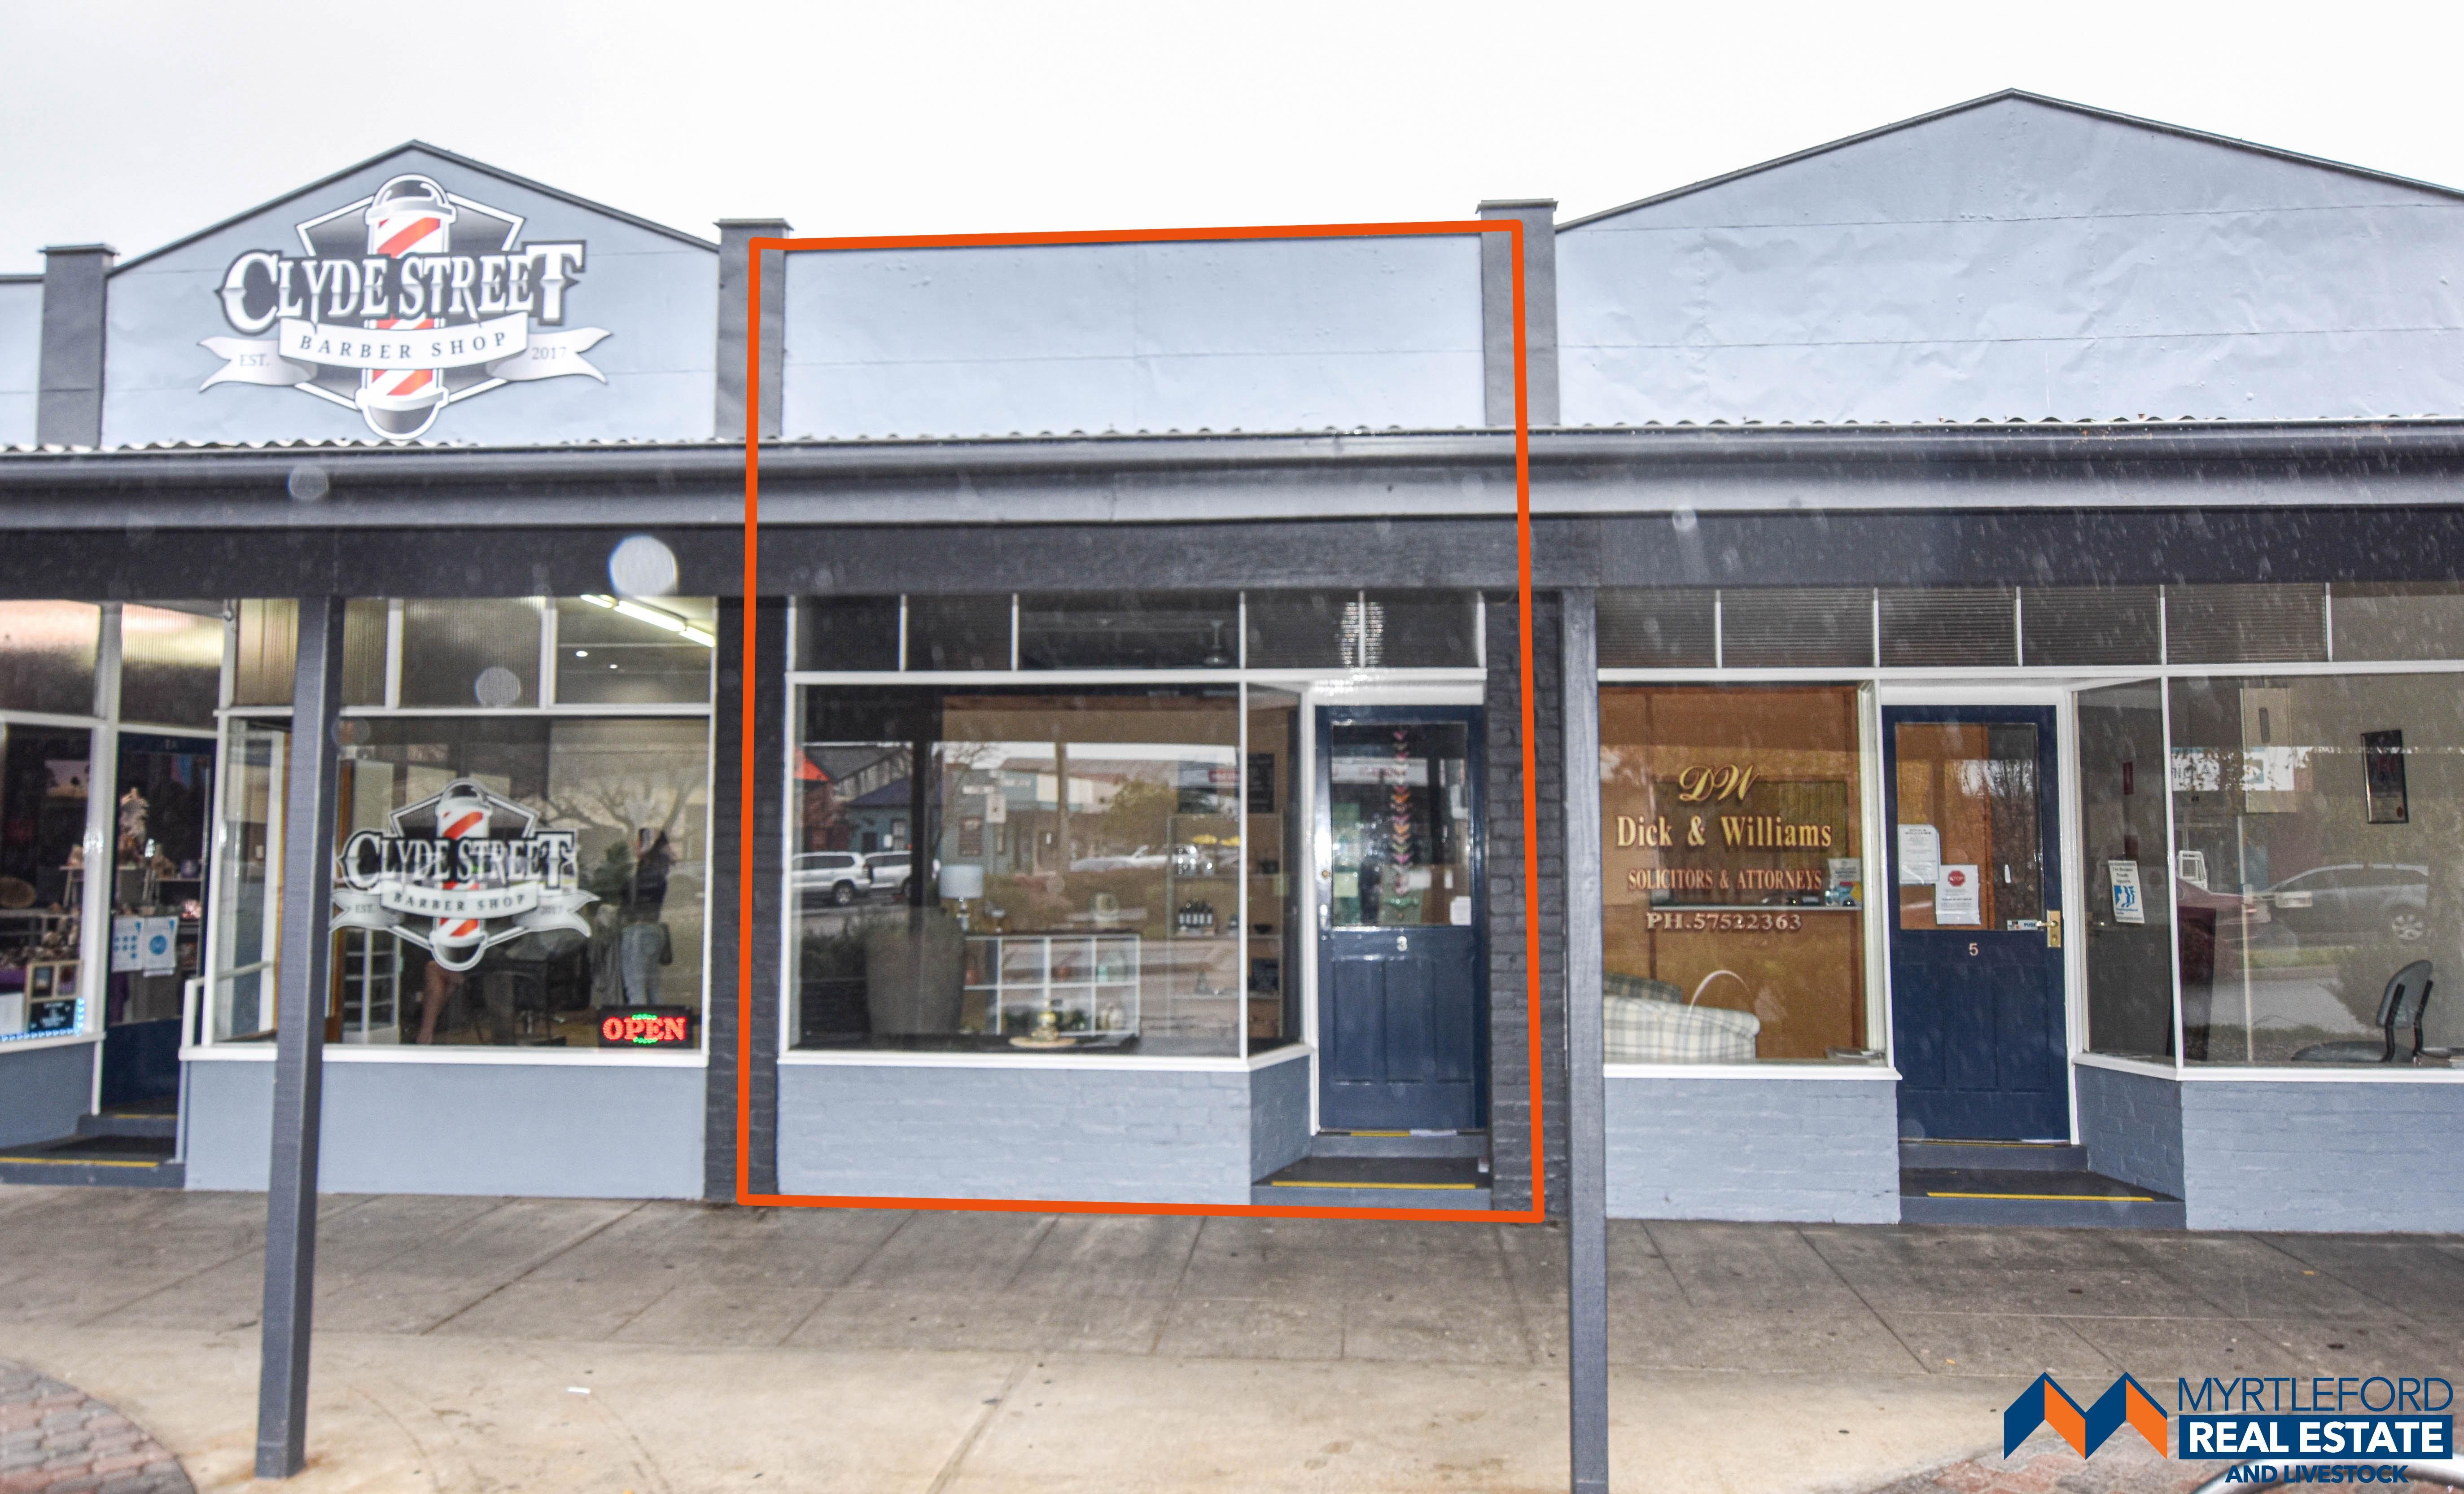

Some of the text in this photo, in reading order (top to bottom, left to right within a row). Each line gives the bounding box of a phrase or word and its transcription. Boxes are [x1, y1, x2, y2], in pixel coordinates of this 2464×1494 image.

[221, 243, 583, 333] CLYDE STREET
[240, 346, 567, 367] EST. 2017
[300, 332, 505, 359] BARBER SHOP
[1679, 764, 1760, 801] DW
[1617, 815, 1831, 847] Dick & Williams
[345, 832, 574, 889] CLYDE STREET
[1628, 869, 1713, 890] SOLICITORS
[1719, 869, 1730, 890] &
[1737, 869, 1823, 890] ATTORNEYS
[394, 892, 524, 911] BARBER SHOP
[1646, 911, 1802, 930] PH.57522363
[1396, 936, 1408, 952] 3
[1969, 943, 1978, 956] 5
[603, 1016, 687, 1041] OPEN
